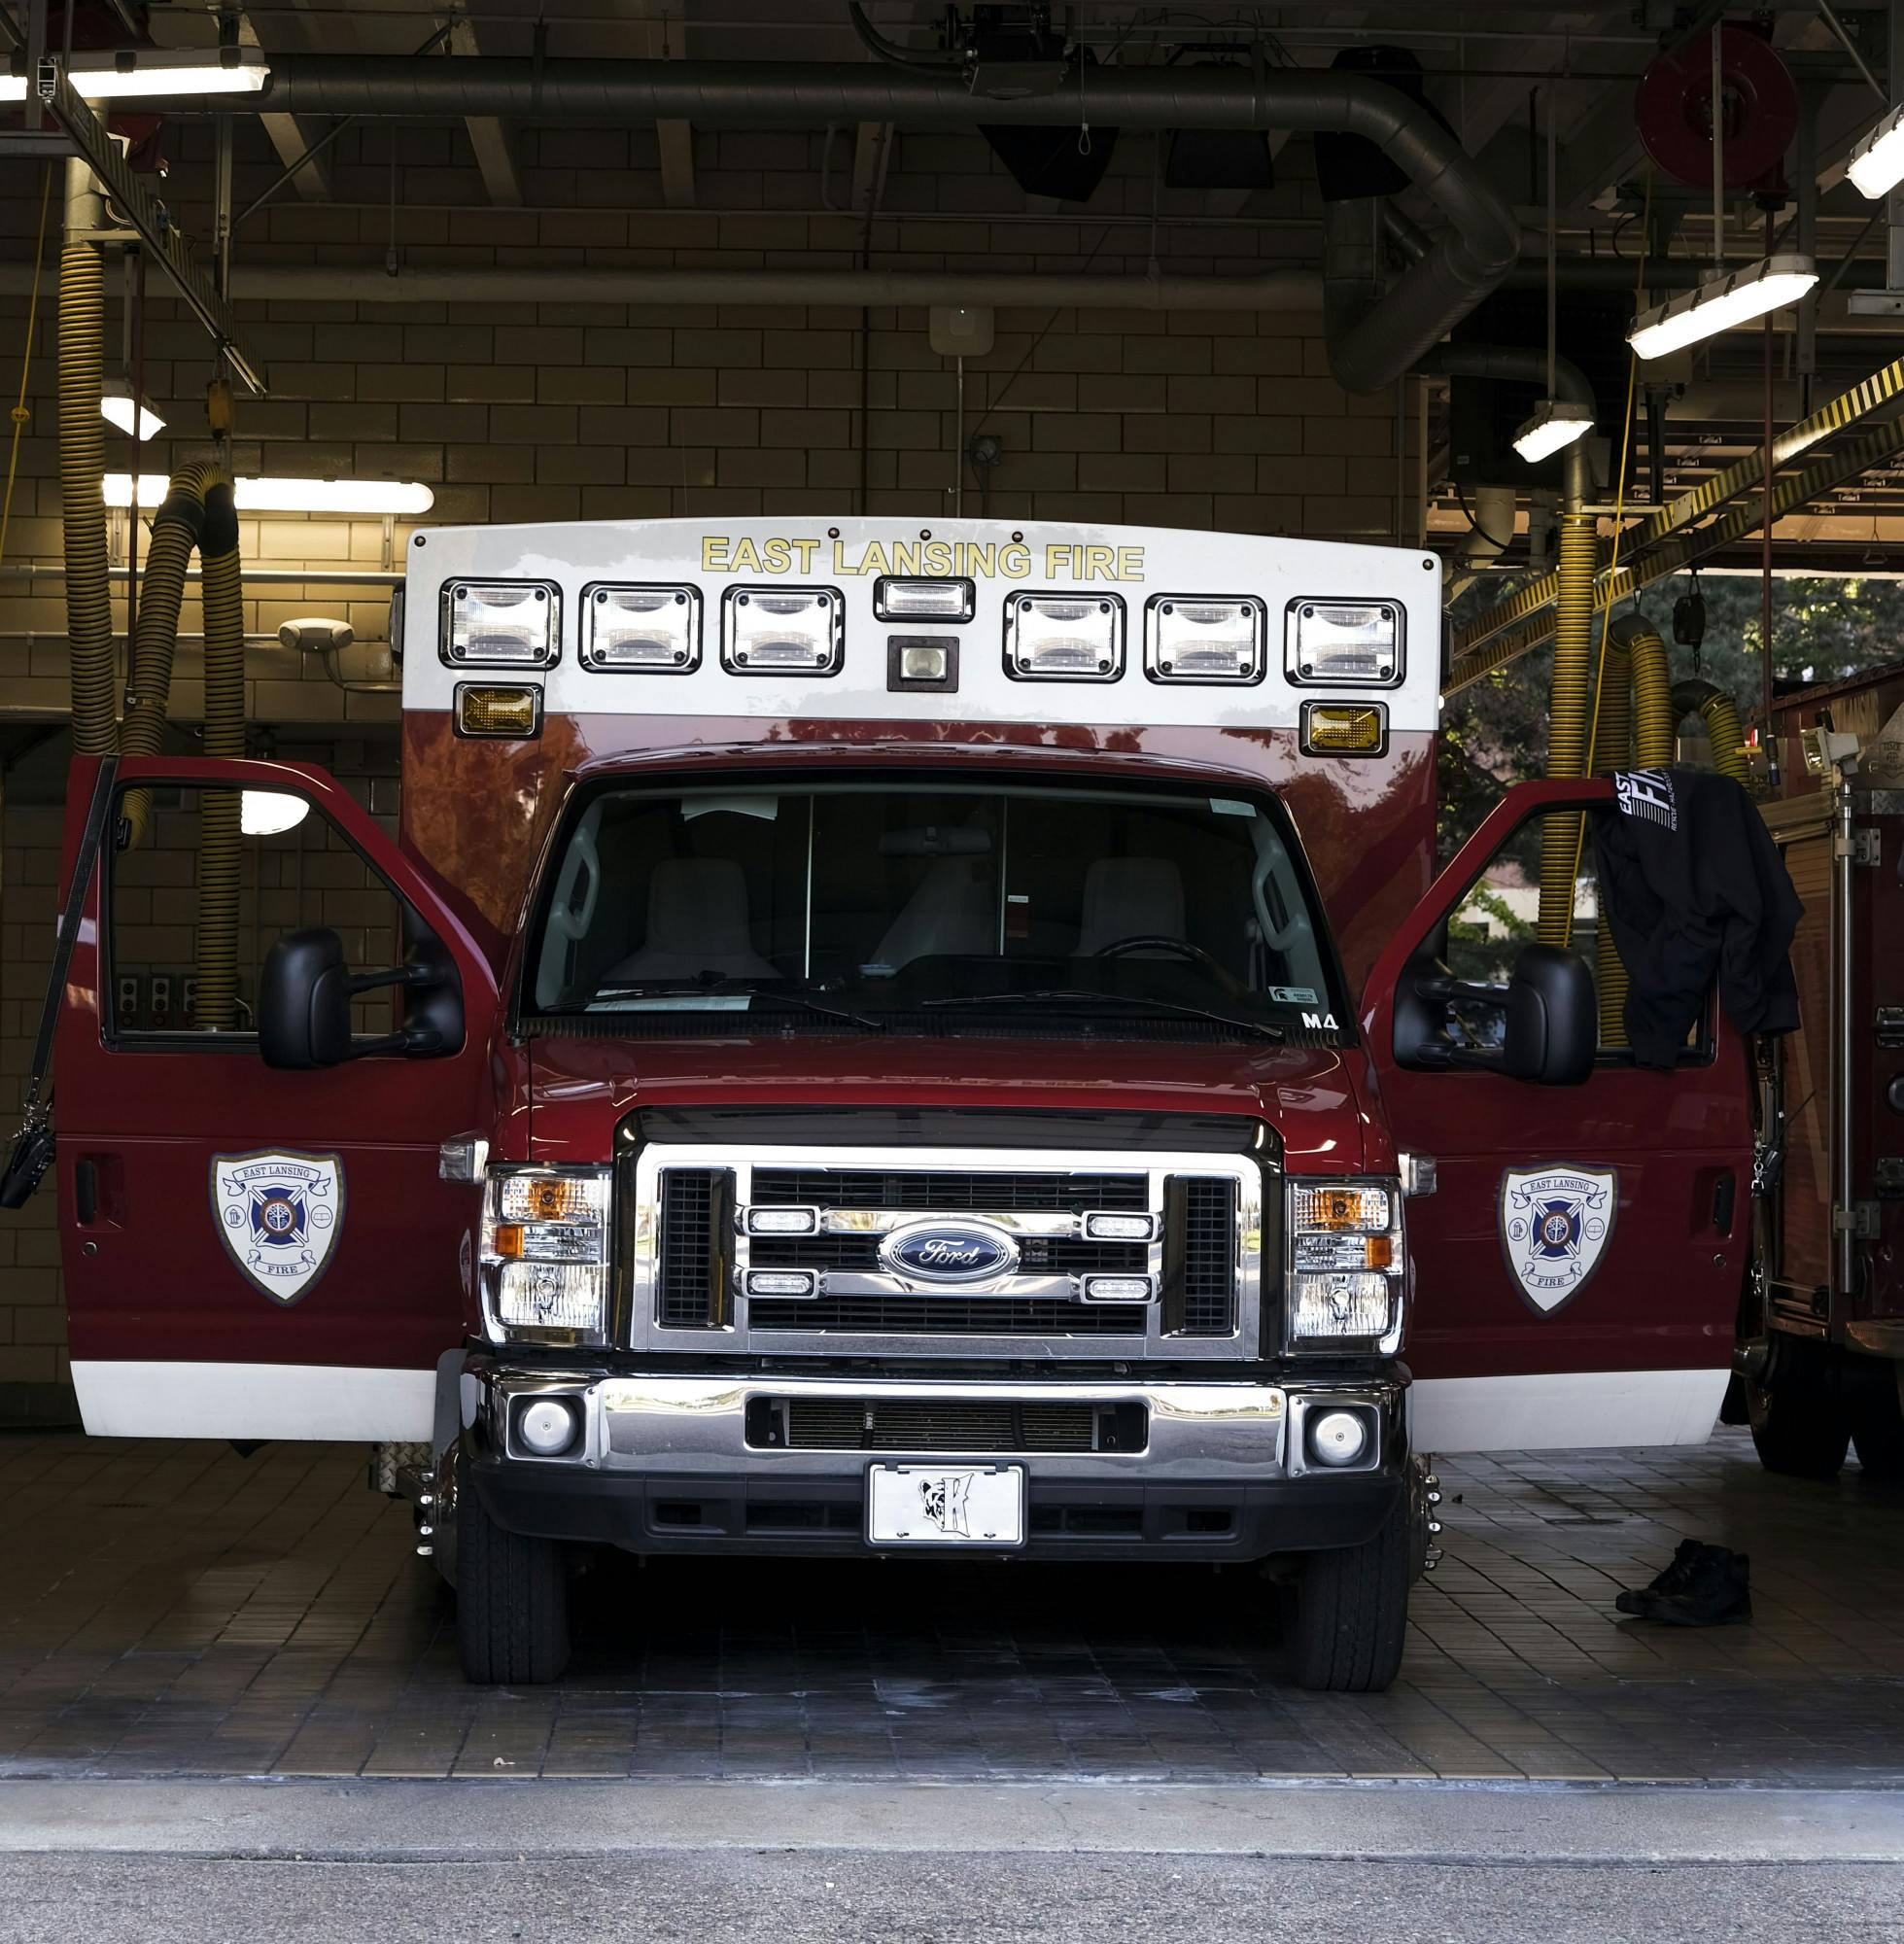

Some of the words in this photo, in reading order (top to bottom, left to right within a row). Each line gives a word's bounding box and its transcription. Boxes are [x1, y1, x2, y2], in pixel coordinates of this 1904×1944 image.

[701, 536, 821, 574] EAST
[833, 539, 1031, 578] LANSING
[1045, 544, 1145, 582] FIRE
[1614, 771, 1633, 816] EAST
[1300, 1012, 1340, 1030] M4
[243, 1167, 266, 1178] EAST
[269, 1165, 310, 1178] LANSING
[1530, 1180, 1552, 1191] EAST
[1553, 1180, 1589, 1191] LANSING
[918, 1238, 981, 1265] Ford
[267, 1266, 298, 1274] FIRE
[1538, 1277, 1565, 1286] FIRE
